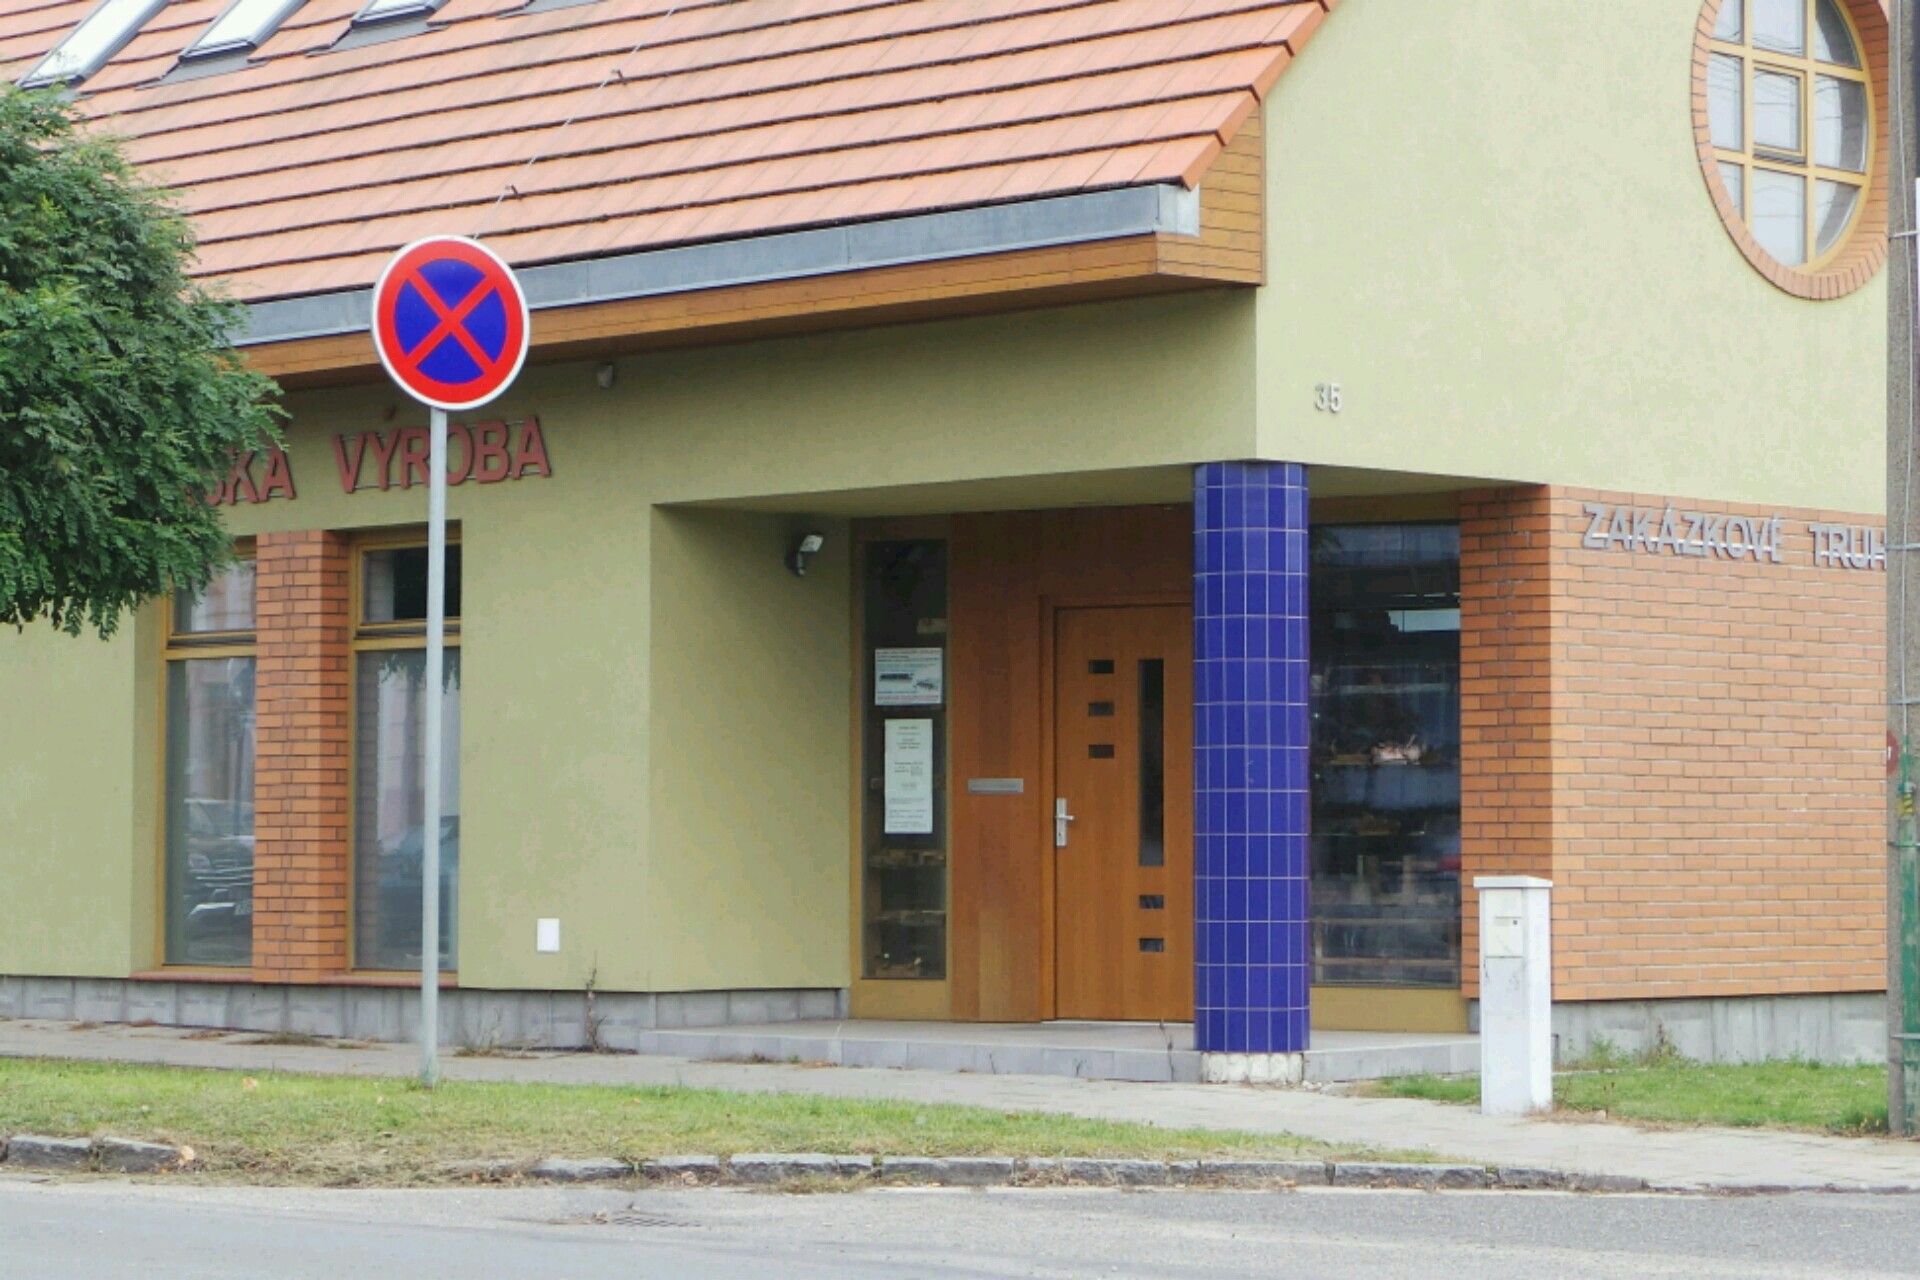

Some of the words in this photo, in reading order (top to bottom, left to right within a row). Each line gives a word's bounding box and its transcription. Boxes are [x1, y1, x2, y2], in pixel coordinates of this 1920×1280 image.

[1314, 383, 1342, 413] 35
[331, 405, 552, 493] VÝROBA
[1583, 500, 1784, 562] ZAKÁZKOVÉ
